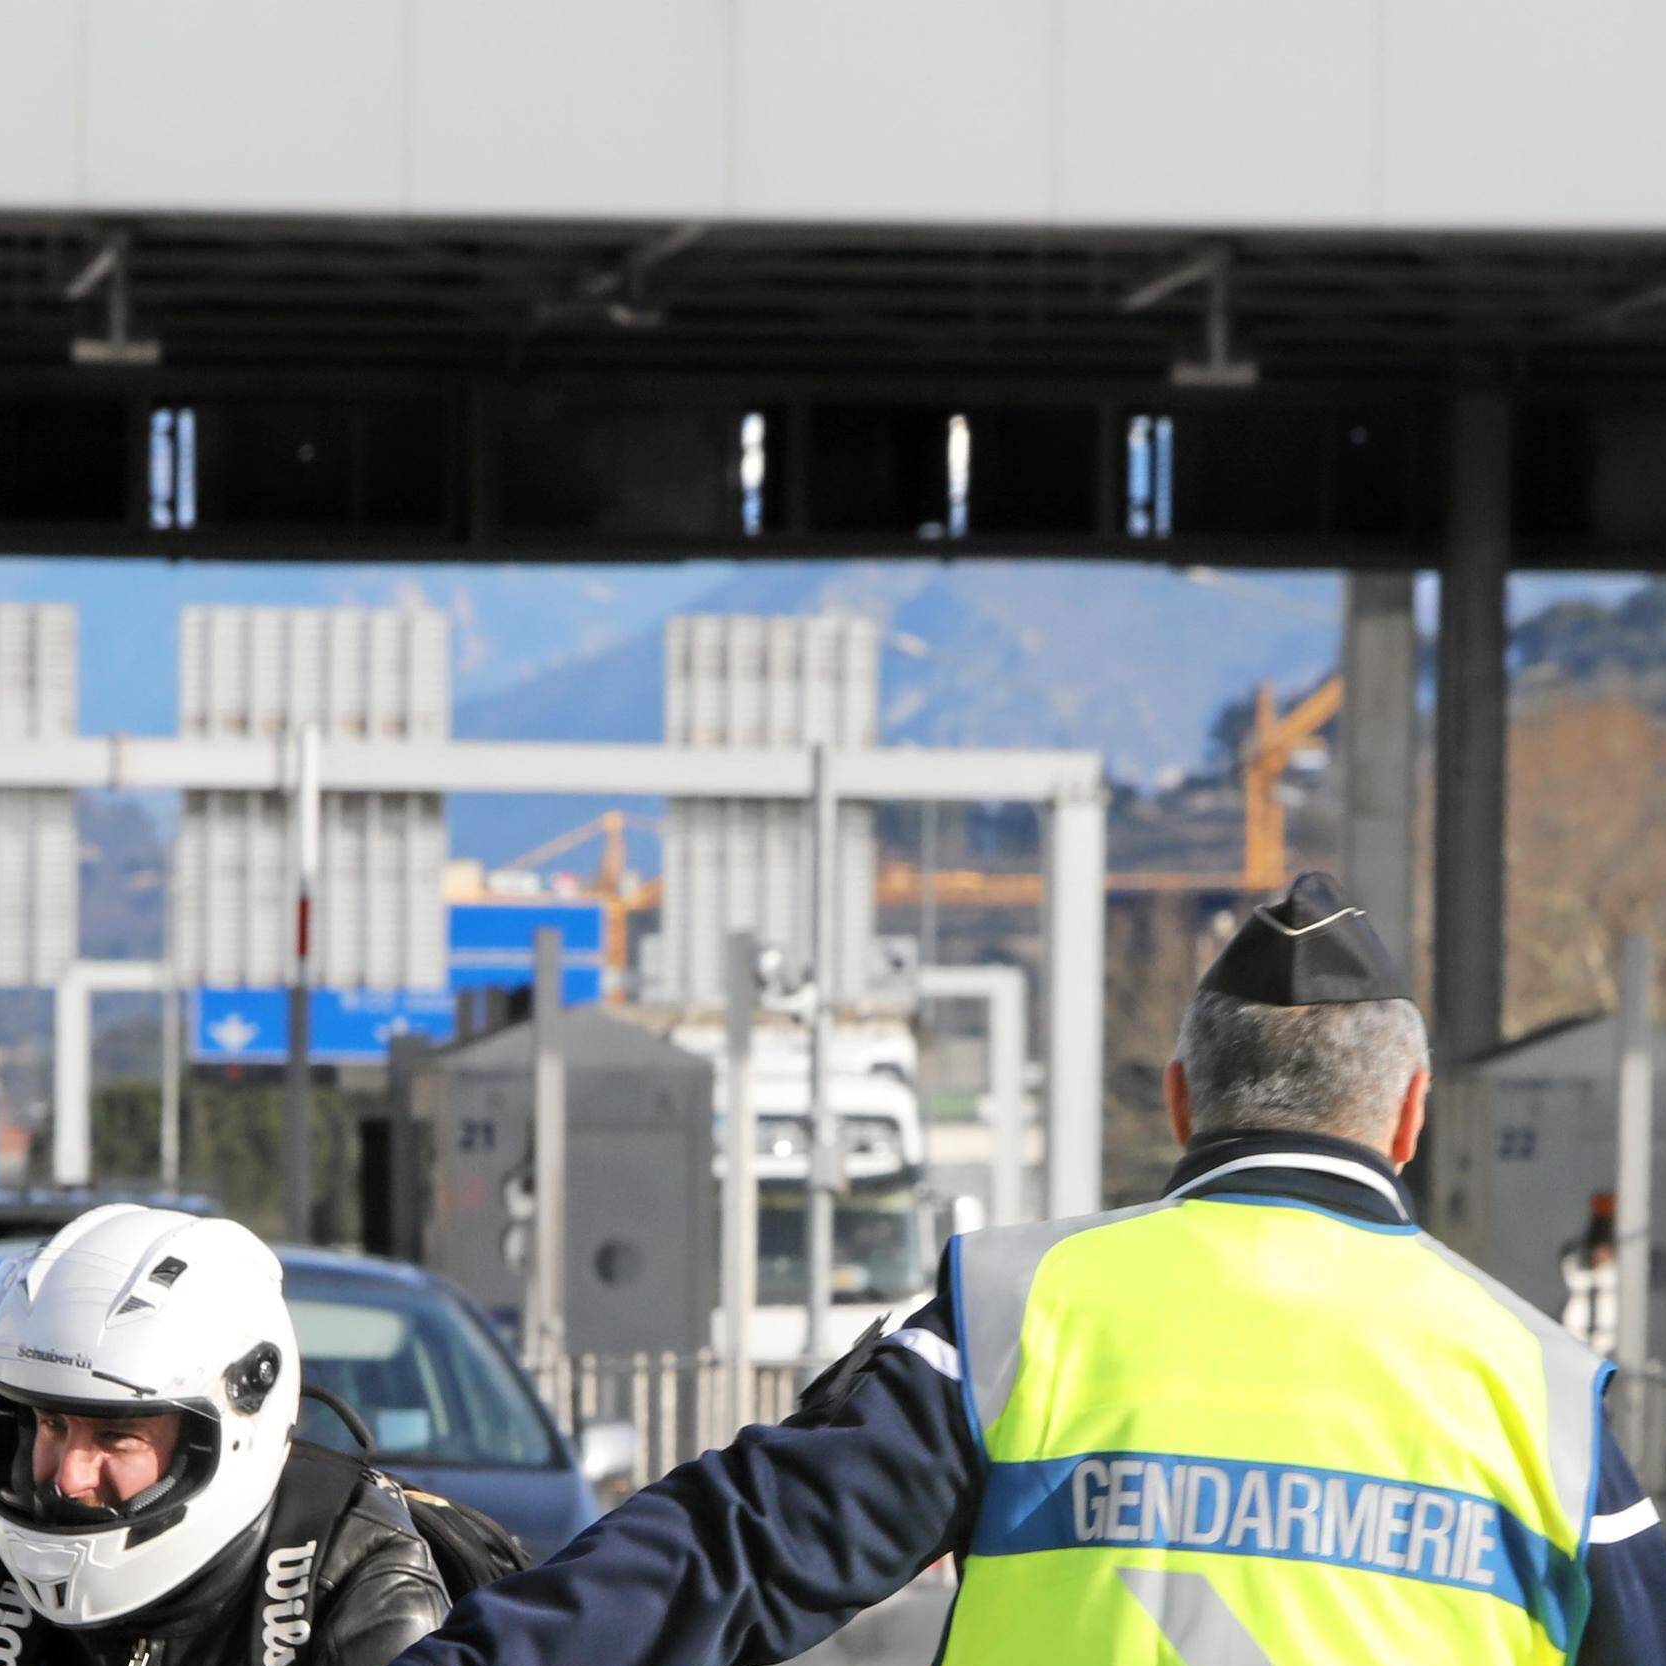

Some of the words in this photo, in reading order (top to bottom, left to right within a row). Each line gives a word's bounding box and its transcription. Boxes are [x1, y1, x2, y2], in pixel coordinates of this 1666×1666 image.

[459, 1118, 495, 1152] 21
[1500, 1127, 1536, 1160] 22
[1072, 1469, 1496, 1586] GENDARMERIE
